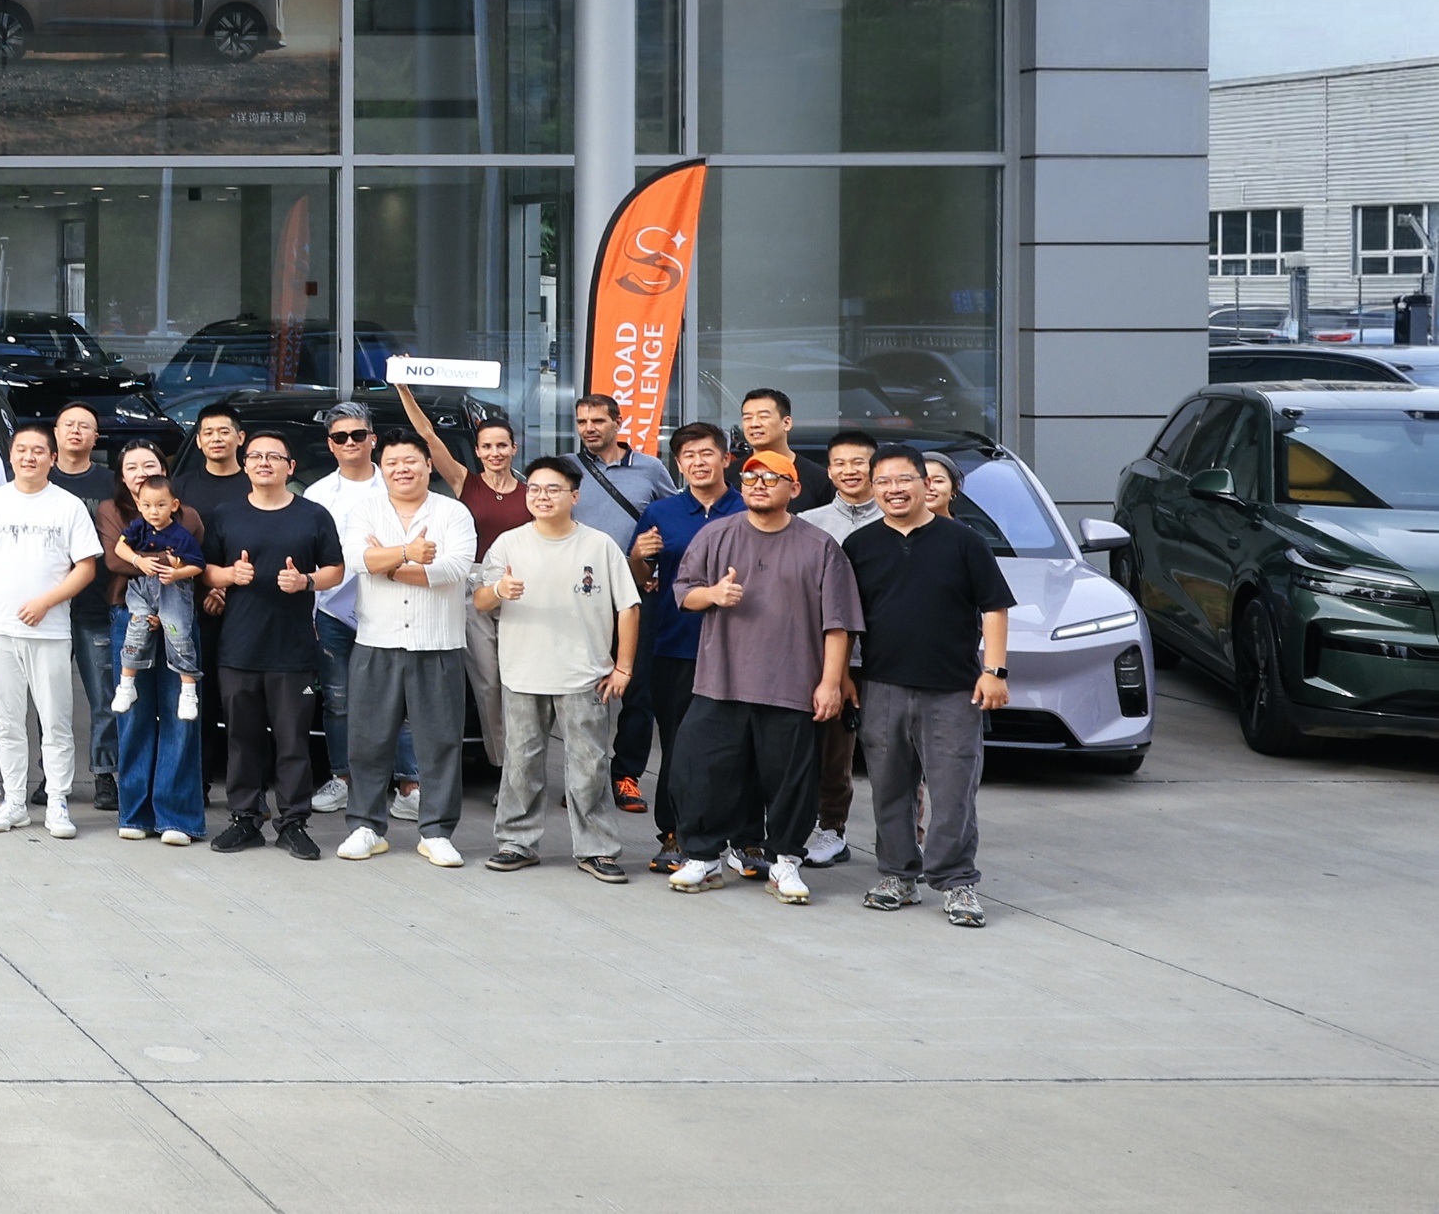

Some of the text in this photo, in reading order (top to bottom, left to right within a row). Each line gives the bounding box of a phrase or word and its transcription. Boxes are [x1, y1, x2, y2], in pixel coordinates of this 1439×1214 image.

[406, 365, 480, 379] NIO Power
[612, 321, 638, 407] ROAD
